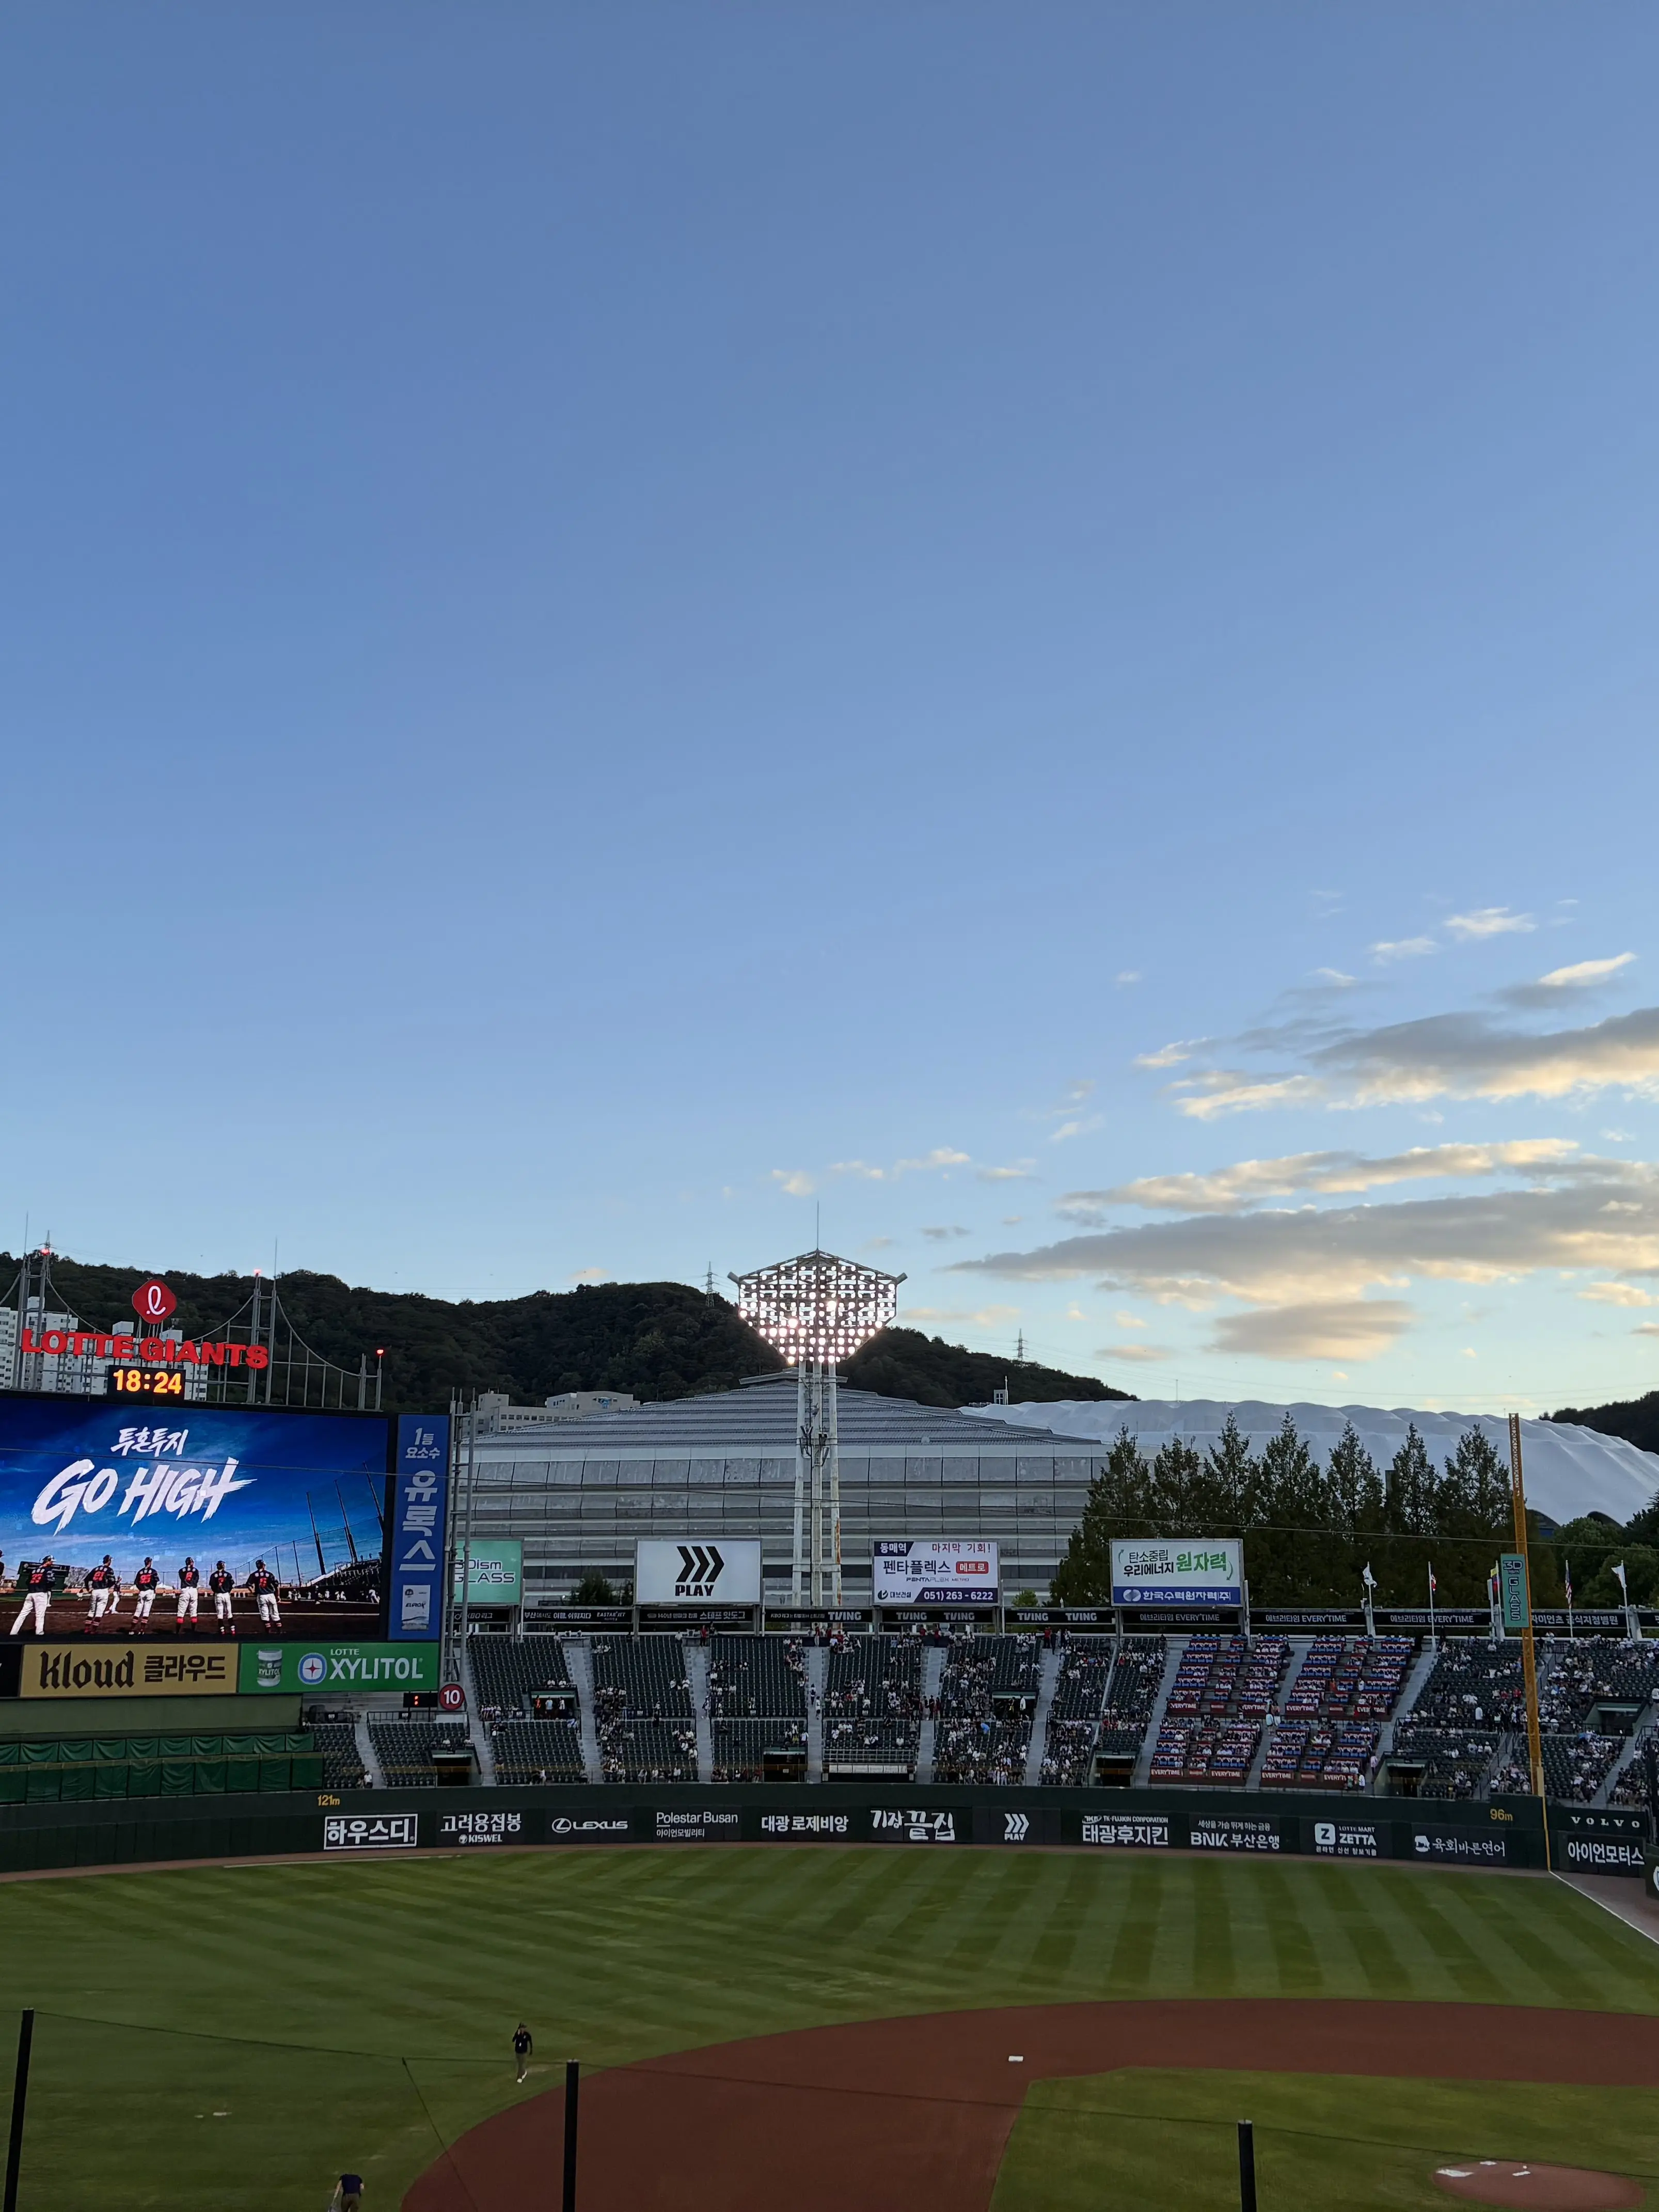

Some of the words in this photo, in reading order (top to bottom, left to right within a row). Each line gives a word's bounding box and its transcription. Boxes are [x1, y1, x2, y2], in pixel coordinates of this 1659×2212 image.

[22, 1329, 133, 1359] LOTTE
[140, 1336, 268, 1370] GIANTS
[113, 1369, 182, 1394] 18:24
[110, 1426, 188, 1457] 투혼투지
[415, 1428, 434, 1445] 1등
[405, 1447, 440, 1459] 요소수
[31, 1459, 118, 1536] GO
[117, 1457, 257, 1527] HIGH
[399, 1470, 437, 1571] 유록스
[932, 1543, 961, 1553] 마지막
[967, 1543, 991, 1553] 기회!
[1129, 1550, 1168, 1563] 탄소중립
[1177, 1552, 1226, 1572] 원자력
[883, 1560, 951, 1575] 펜타플렉스
[959, 1563, 986, 1572] 메트로
[1124, 1562, 1174, 1577] 우리에너지
[1503, 1560, 1523, 1570] 3D
[675, 1585, 714, 1596] PLAY
[923, 1590, 944, 1601] 051)
[946, 1591, 963, 1600] 263
[970, 1590, 994, 1600] 6222
[1508, 1577, 1521, 1620] GLASS
[828, 1611, 862, 1620] TVING
[896, 1611, 927, 1620] TVING
[944, 1611, 975, 1620] TVING
[1017, 1613, 1049, 1621] TVING
[1065, 1613, 1097, 1621] TVING
[40, 1650, 134, 1689] Kloud
[144, 1655, 226, 1682] 클라우드
[329, 1657, 423, 1680] XYLITOL
[444, 1689, 461, 1704] 10
[318, 1794, 341, 1806] 121m
[656, 1811, 702, 1824] Polestar
[703, 1811, 738, 1824] Busan
[1490, 1808, 1513, 1821] 96m
[440, 1813, 522, 1832] 고려용접봉
[573, 1821, 628, 1830] LEXUS
[762, 1815, 790, 1832] 대광
[792, 1815, 849, 1832] 로제비앙
[1198, 1820, 1216, 1829] 세상을
[1570, 1816, 1640, 1828] VOLVO
[327, 1818, 410, 1845] 하우스디
[468, 1834, 503, 1843] KISWEL
[656, 1828, 705, 1838] 아이언모빌리티
[1082, 1824, 1168, 1845] 태광후지킨
[1191, 1831, 1229, 1847] BNK
[1230, 1833, 1280, 1850] 부산은행
[1339, 1832, 1377, 1846] ZETTA
[1432, 1838, 1506, 1857] 육회바른연어
[1568, 1841, 1646, 1867] 아이언모터스
